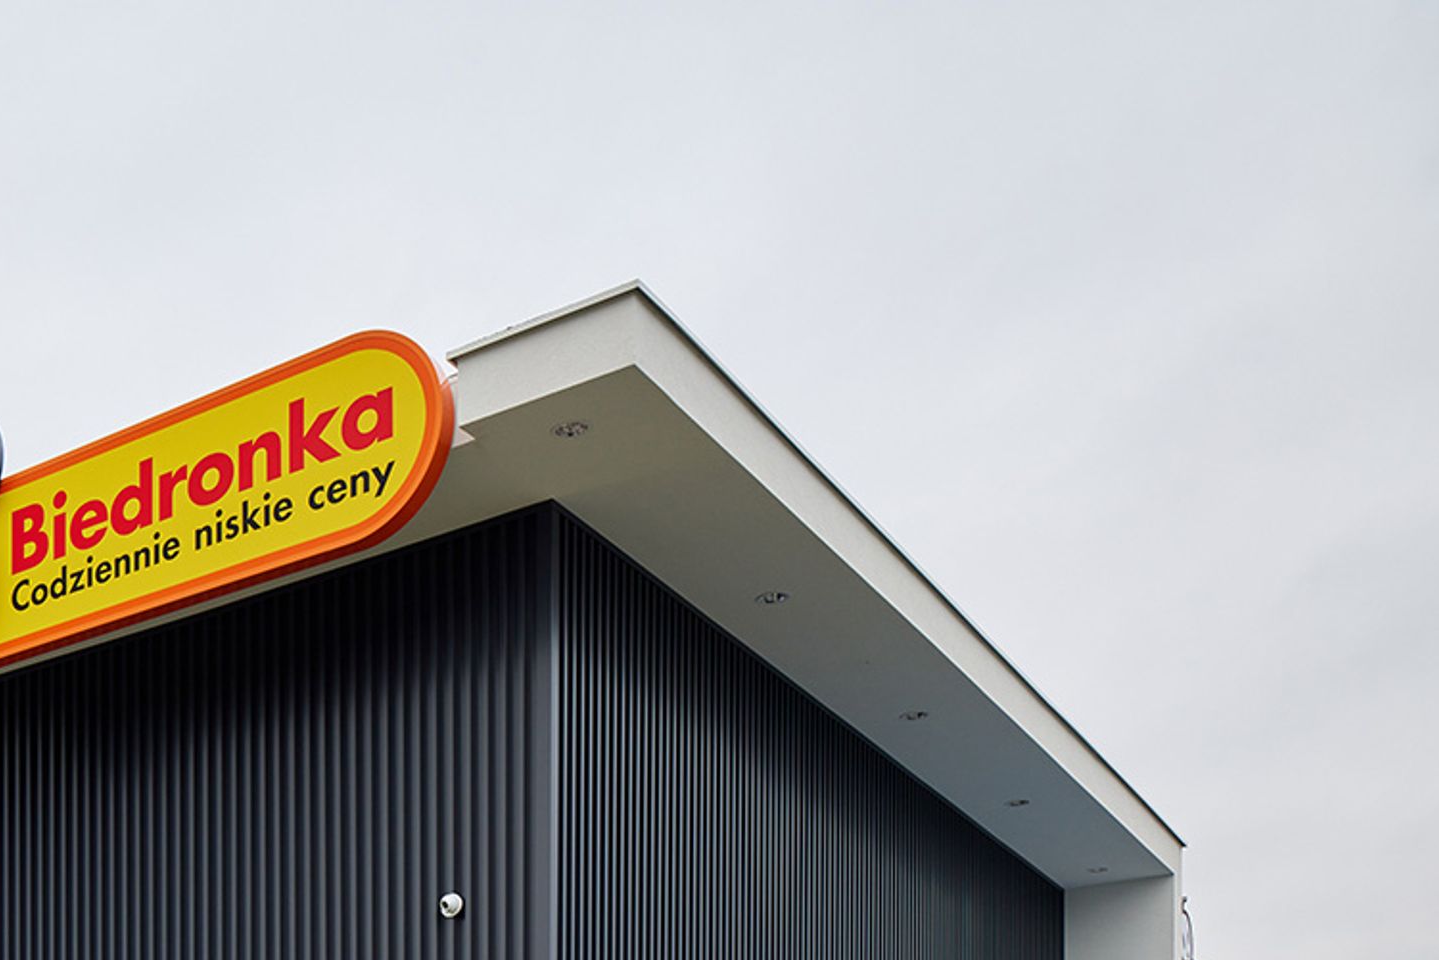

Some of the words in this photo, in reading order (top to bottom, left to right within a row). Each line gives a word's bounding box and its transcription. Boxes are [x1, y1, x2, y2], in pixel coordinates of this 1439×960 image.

[10, 386, 394, 575] Biedronka
[11, 532, 180, 612] Codziennie
[194, 490, 293, 552] niskie
[308, 460, 395, 511] ceny
